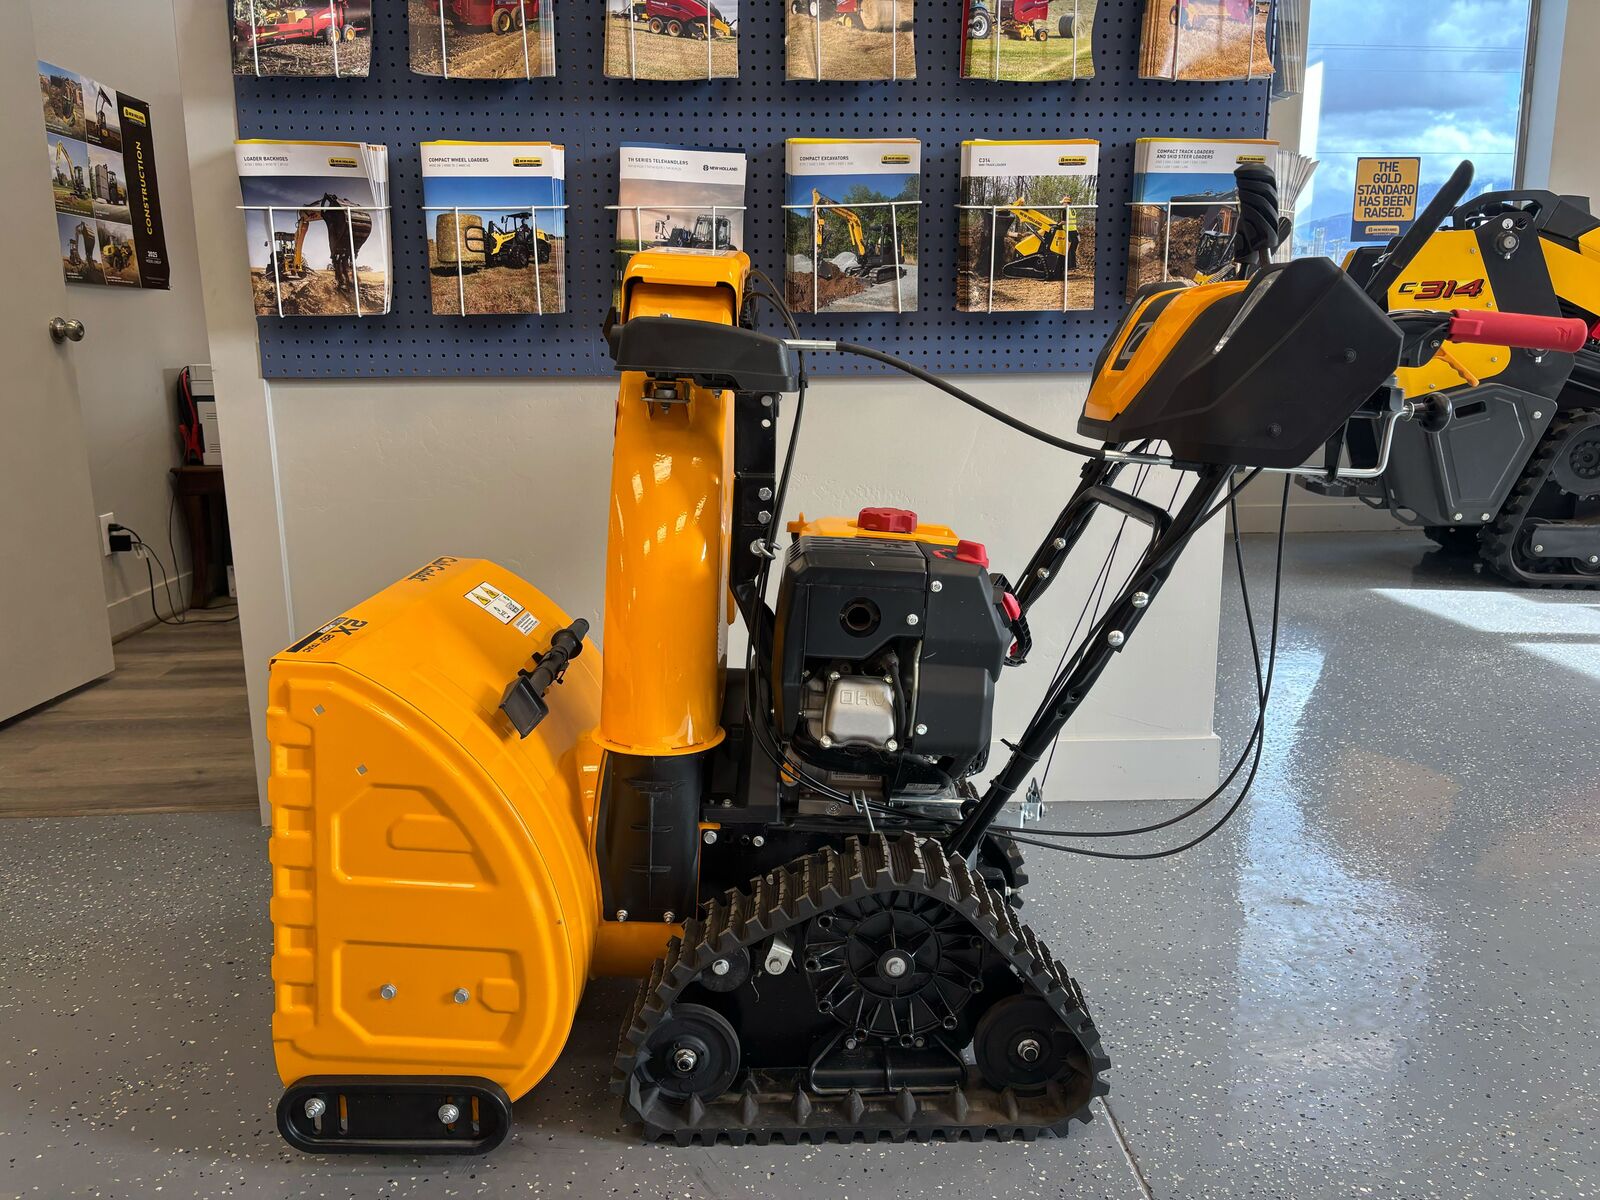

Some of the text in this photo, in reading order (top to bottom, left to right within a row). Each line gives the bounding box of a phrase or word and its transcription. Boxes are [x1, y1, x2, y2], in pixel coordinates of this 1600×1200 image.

[652, 158, 689, 166] TELEHANDLERS
[1378, 161, 1400, 173] THE
[1373, 173, 1402, 184] GOLD
[136, 141, 153, 235] CONSTRUCTION
[1357, 184, 1415, 195] STANDARD
[1358, 195, 1412, 207] HAS BEEN
[1363, 207, 1405, 218] RAISED.
[1397, 278, 1485, 301] C314
[329, 618, 369, 636] 2X
[840, 689, 886, 707] OHV
